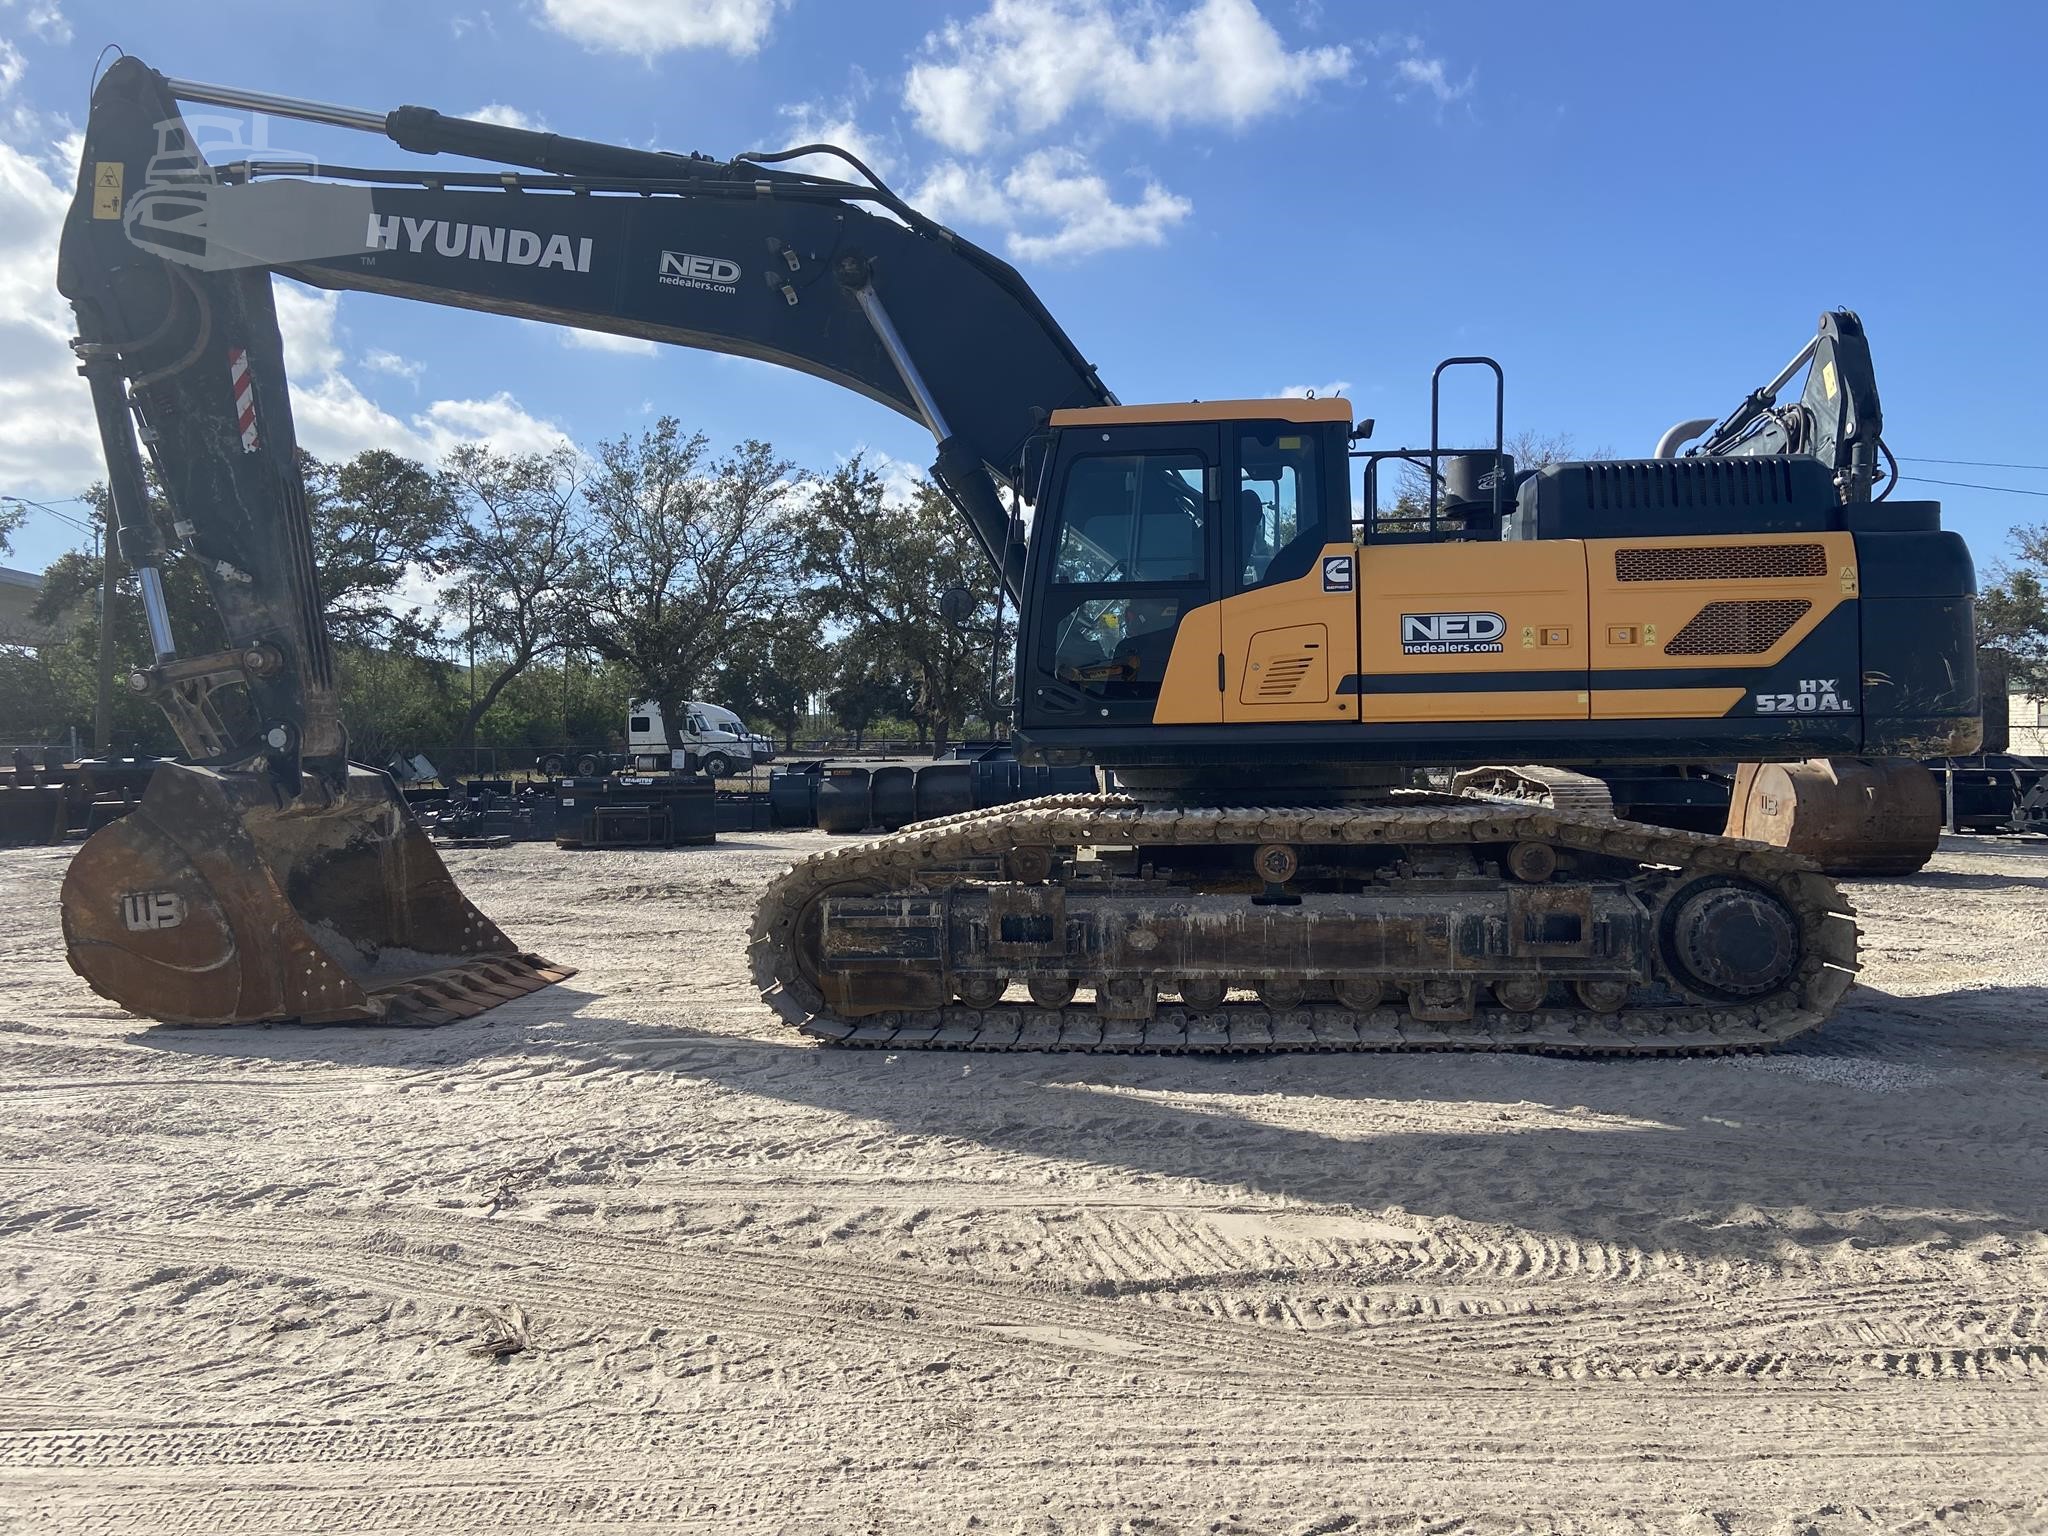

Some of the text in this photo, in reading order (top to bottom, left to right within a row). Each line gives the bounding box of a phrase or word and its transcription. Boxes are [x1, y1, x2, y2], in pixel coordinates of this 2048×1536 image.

[366, 213, 593, 273] HYUNDAI
[360, 256, 376, 266] TM
[661, 252, 740, 282] NED
[659, 276, 736, 294] nedealers.com
[1404, 615, 1504, 641] NED
[1404, 642, 1503, 654] nedealers.com
[1800, 679, 1837, 693] HX
